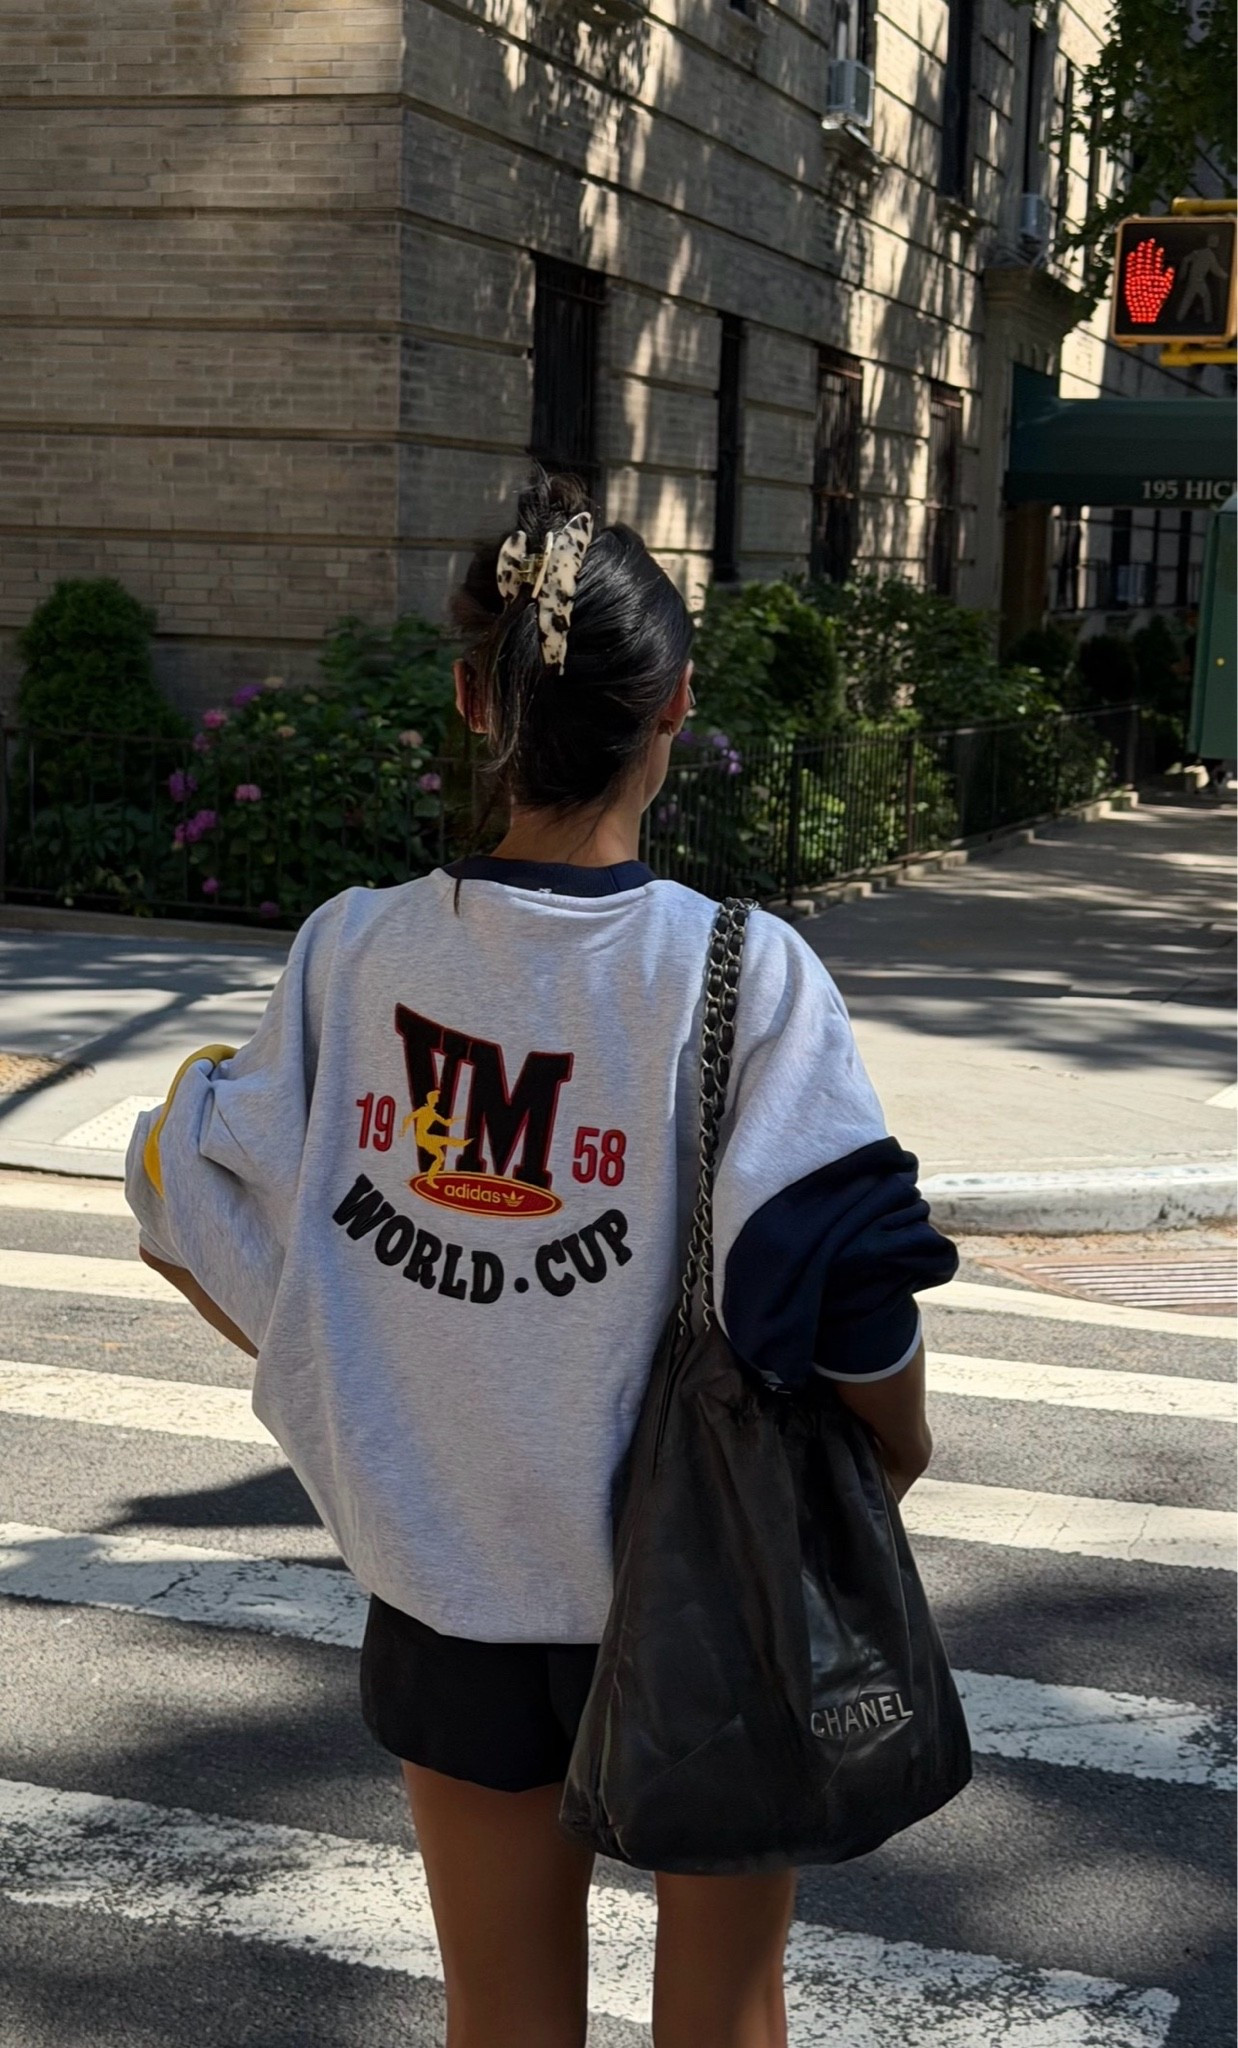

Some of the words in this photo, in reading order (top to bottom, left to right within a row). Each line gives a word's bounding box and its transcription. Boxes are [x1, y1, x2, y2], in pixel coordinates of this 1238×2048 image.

[1142, 480, 1179, 500] 195
[1184, 480, 1238, 500] HIC
[356, 1092, 396, 1152] 19
[395, 1002, 574, 1192] VM
[572, 1126, 627, 1186] 58
[444, 1183, 501, 1204] adidas
[332, 1173, 504, 1304] WORLD
[535, 1209, 632, 1297] CUP
[811, 1693, 914, 1739] CHANEL
